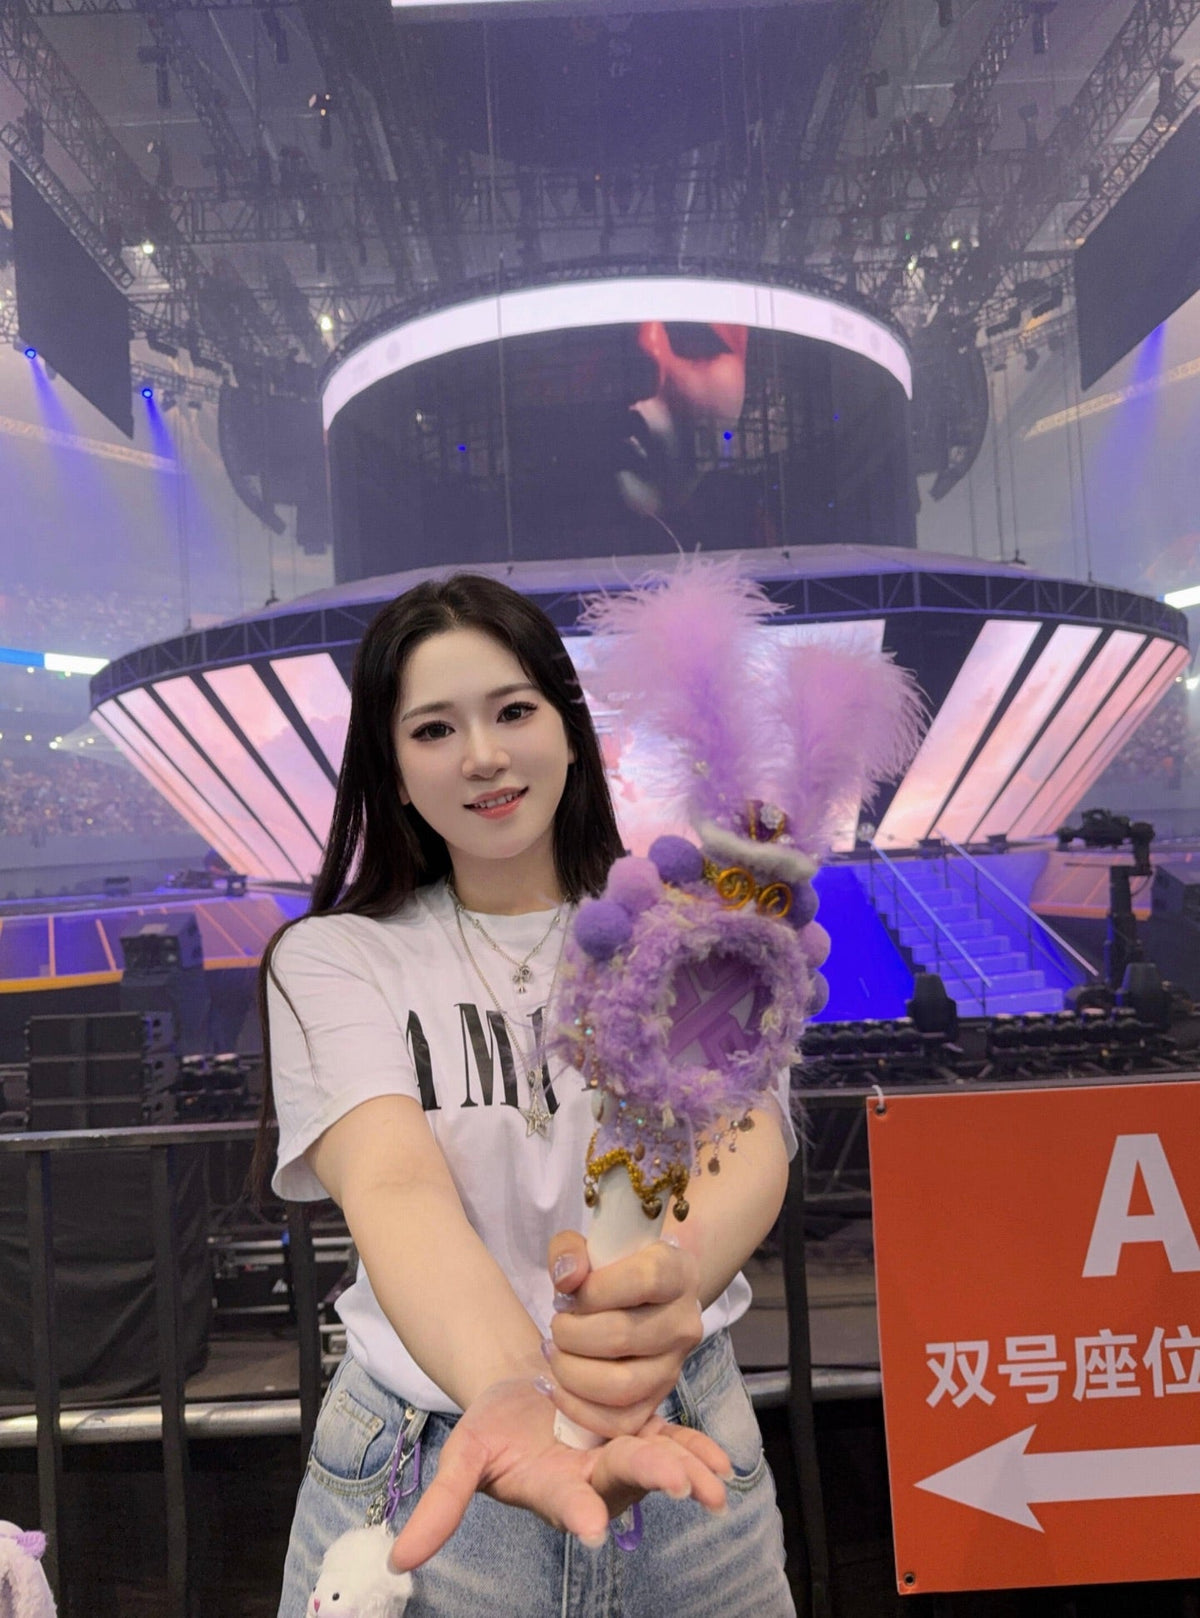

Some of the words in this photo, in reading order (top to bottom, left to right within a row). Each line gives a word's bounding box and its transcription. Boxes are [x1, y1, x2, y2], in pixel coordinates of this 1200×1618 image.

[1082, 1133, 1200, 1278] A
[925, 1325, 1200, 1409] 双号座位
